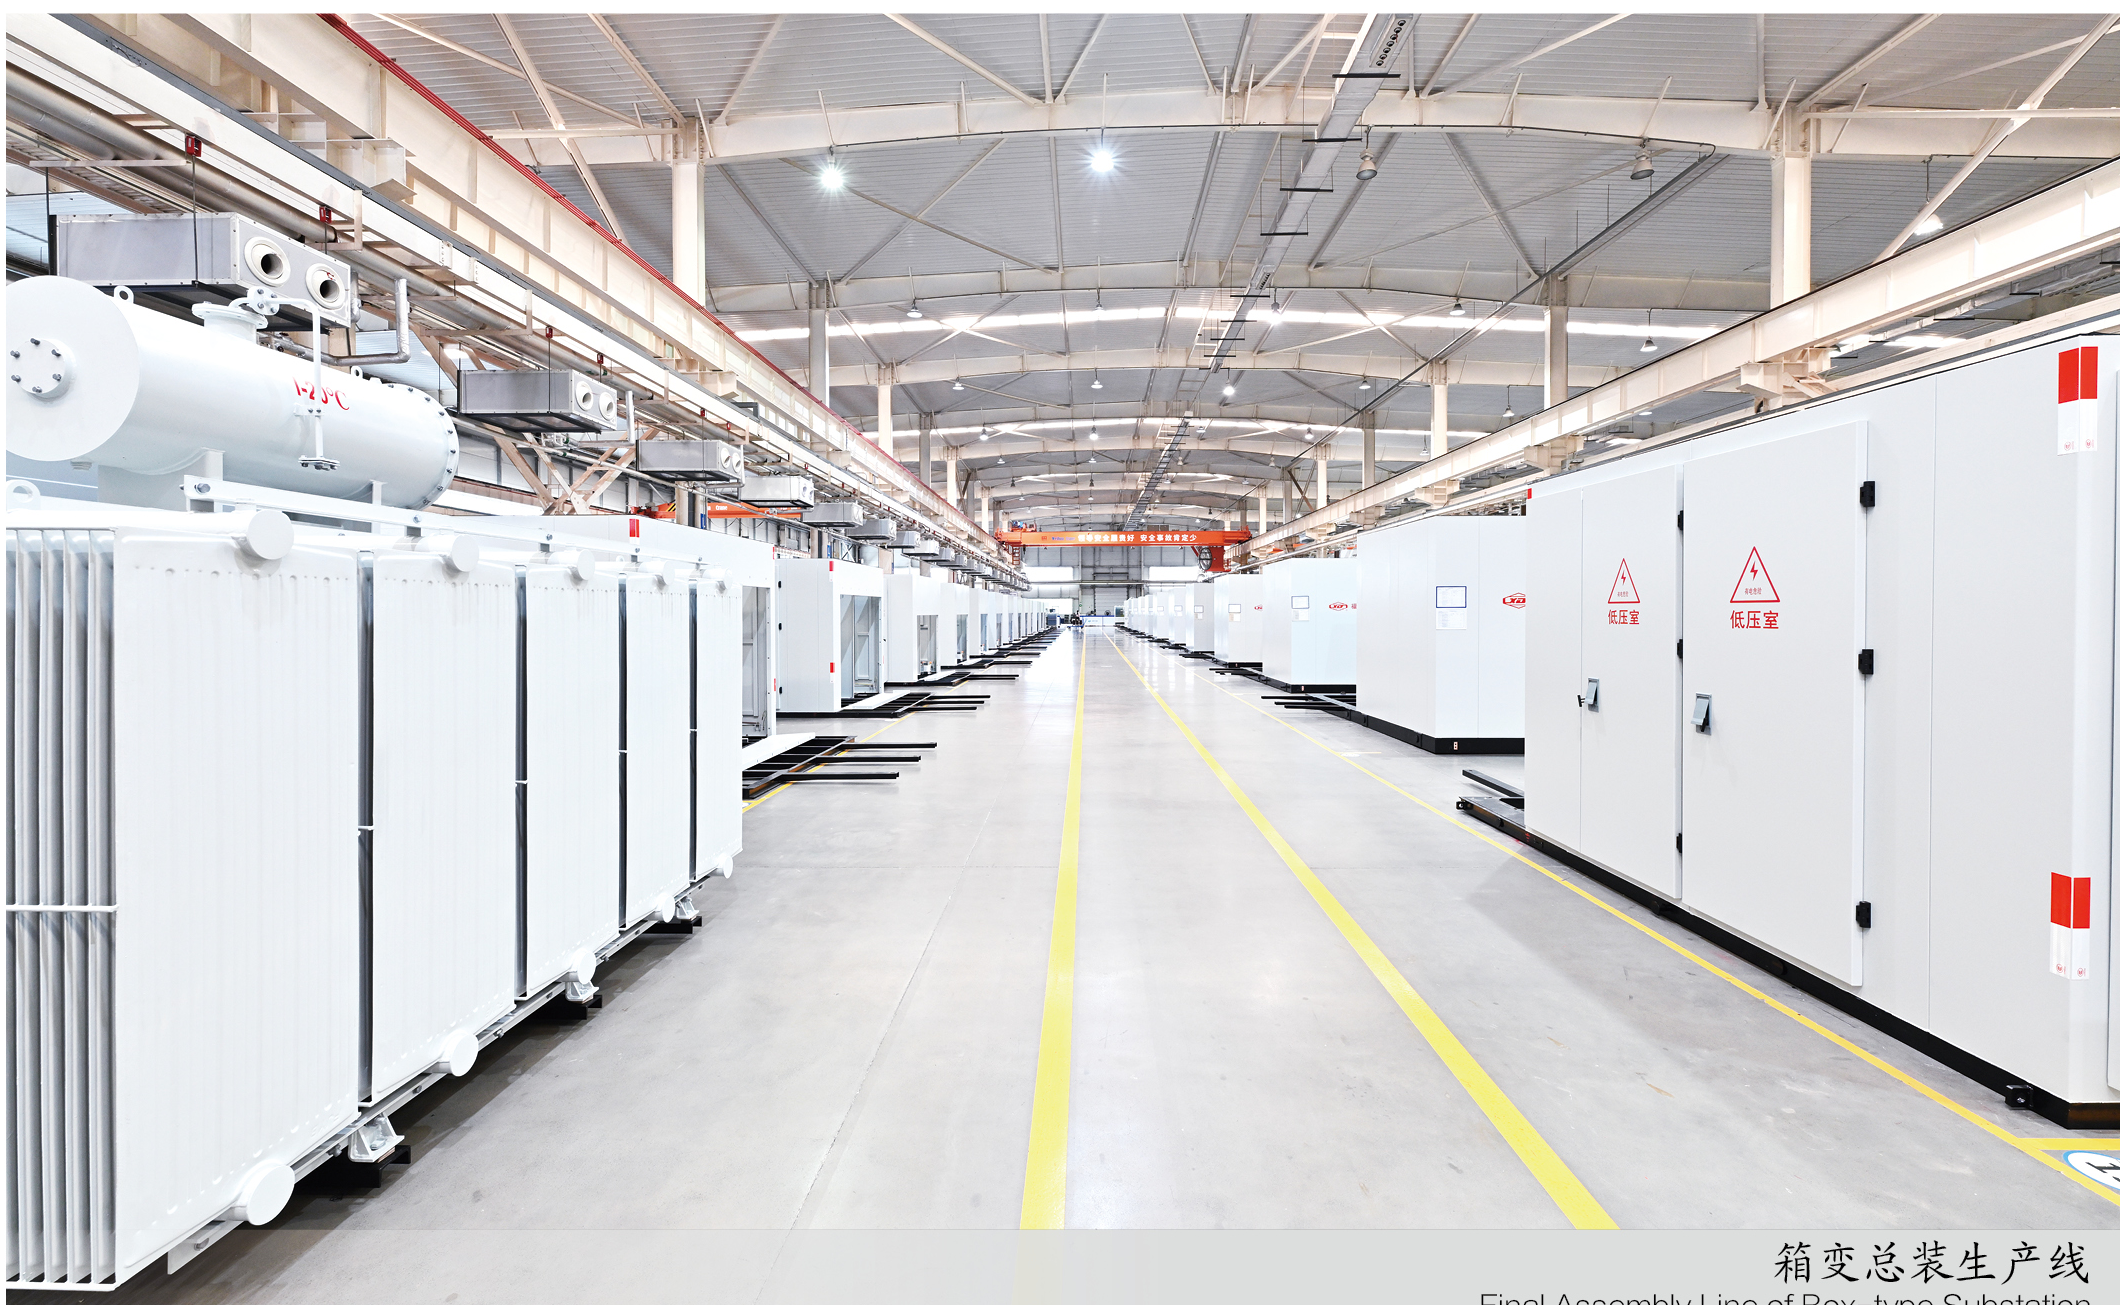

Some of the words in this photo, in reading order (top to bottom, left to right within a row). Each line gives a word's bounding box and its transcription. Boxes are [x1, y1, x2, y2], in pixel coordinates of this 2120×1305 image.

[1140, 533, 1197, 542] 安全事故肯定少
[1608, 609, 1640, 625] 低压室
[1730, 609, 1780, 629] 低压室
